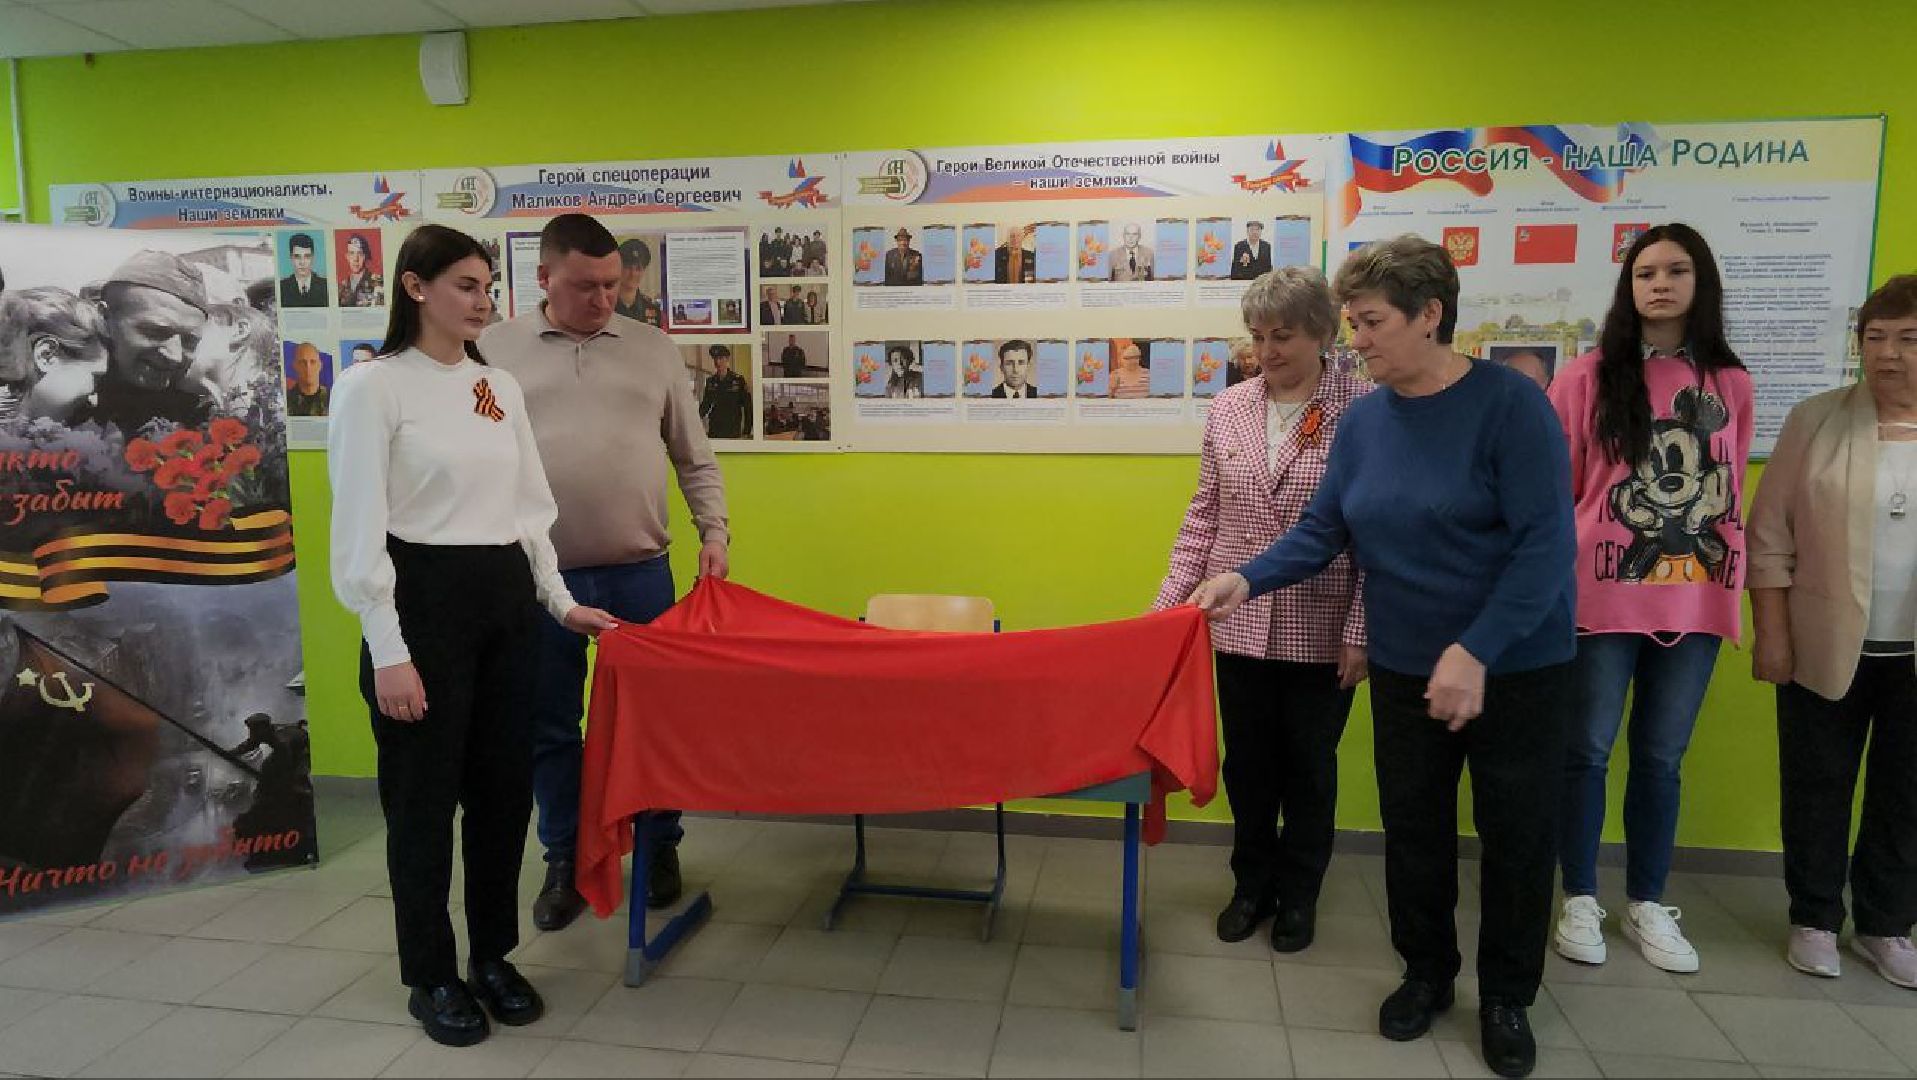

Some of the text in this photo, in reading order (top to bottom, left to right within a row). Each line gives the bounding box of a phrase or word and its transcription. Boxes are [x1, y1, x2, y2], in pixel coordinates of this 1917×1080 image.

[936, 151, 1220, 175] Герои Великой Отечественной войны
[538, 165, 711, 188] Герой спецоперации
[1029, 174, 1069, 189] наши
[1074, 173, 1138, 189] земляки
[128, 183, 333, 202] Воины-интернационалисты.
[512, 187, 742, 209] Маликов Андрей Сергеевич
[178, 206, 285, 222] Наши земляки
[3, 479, 126, 526] забыт
